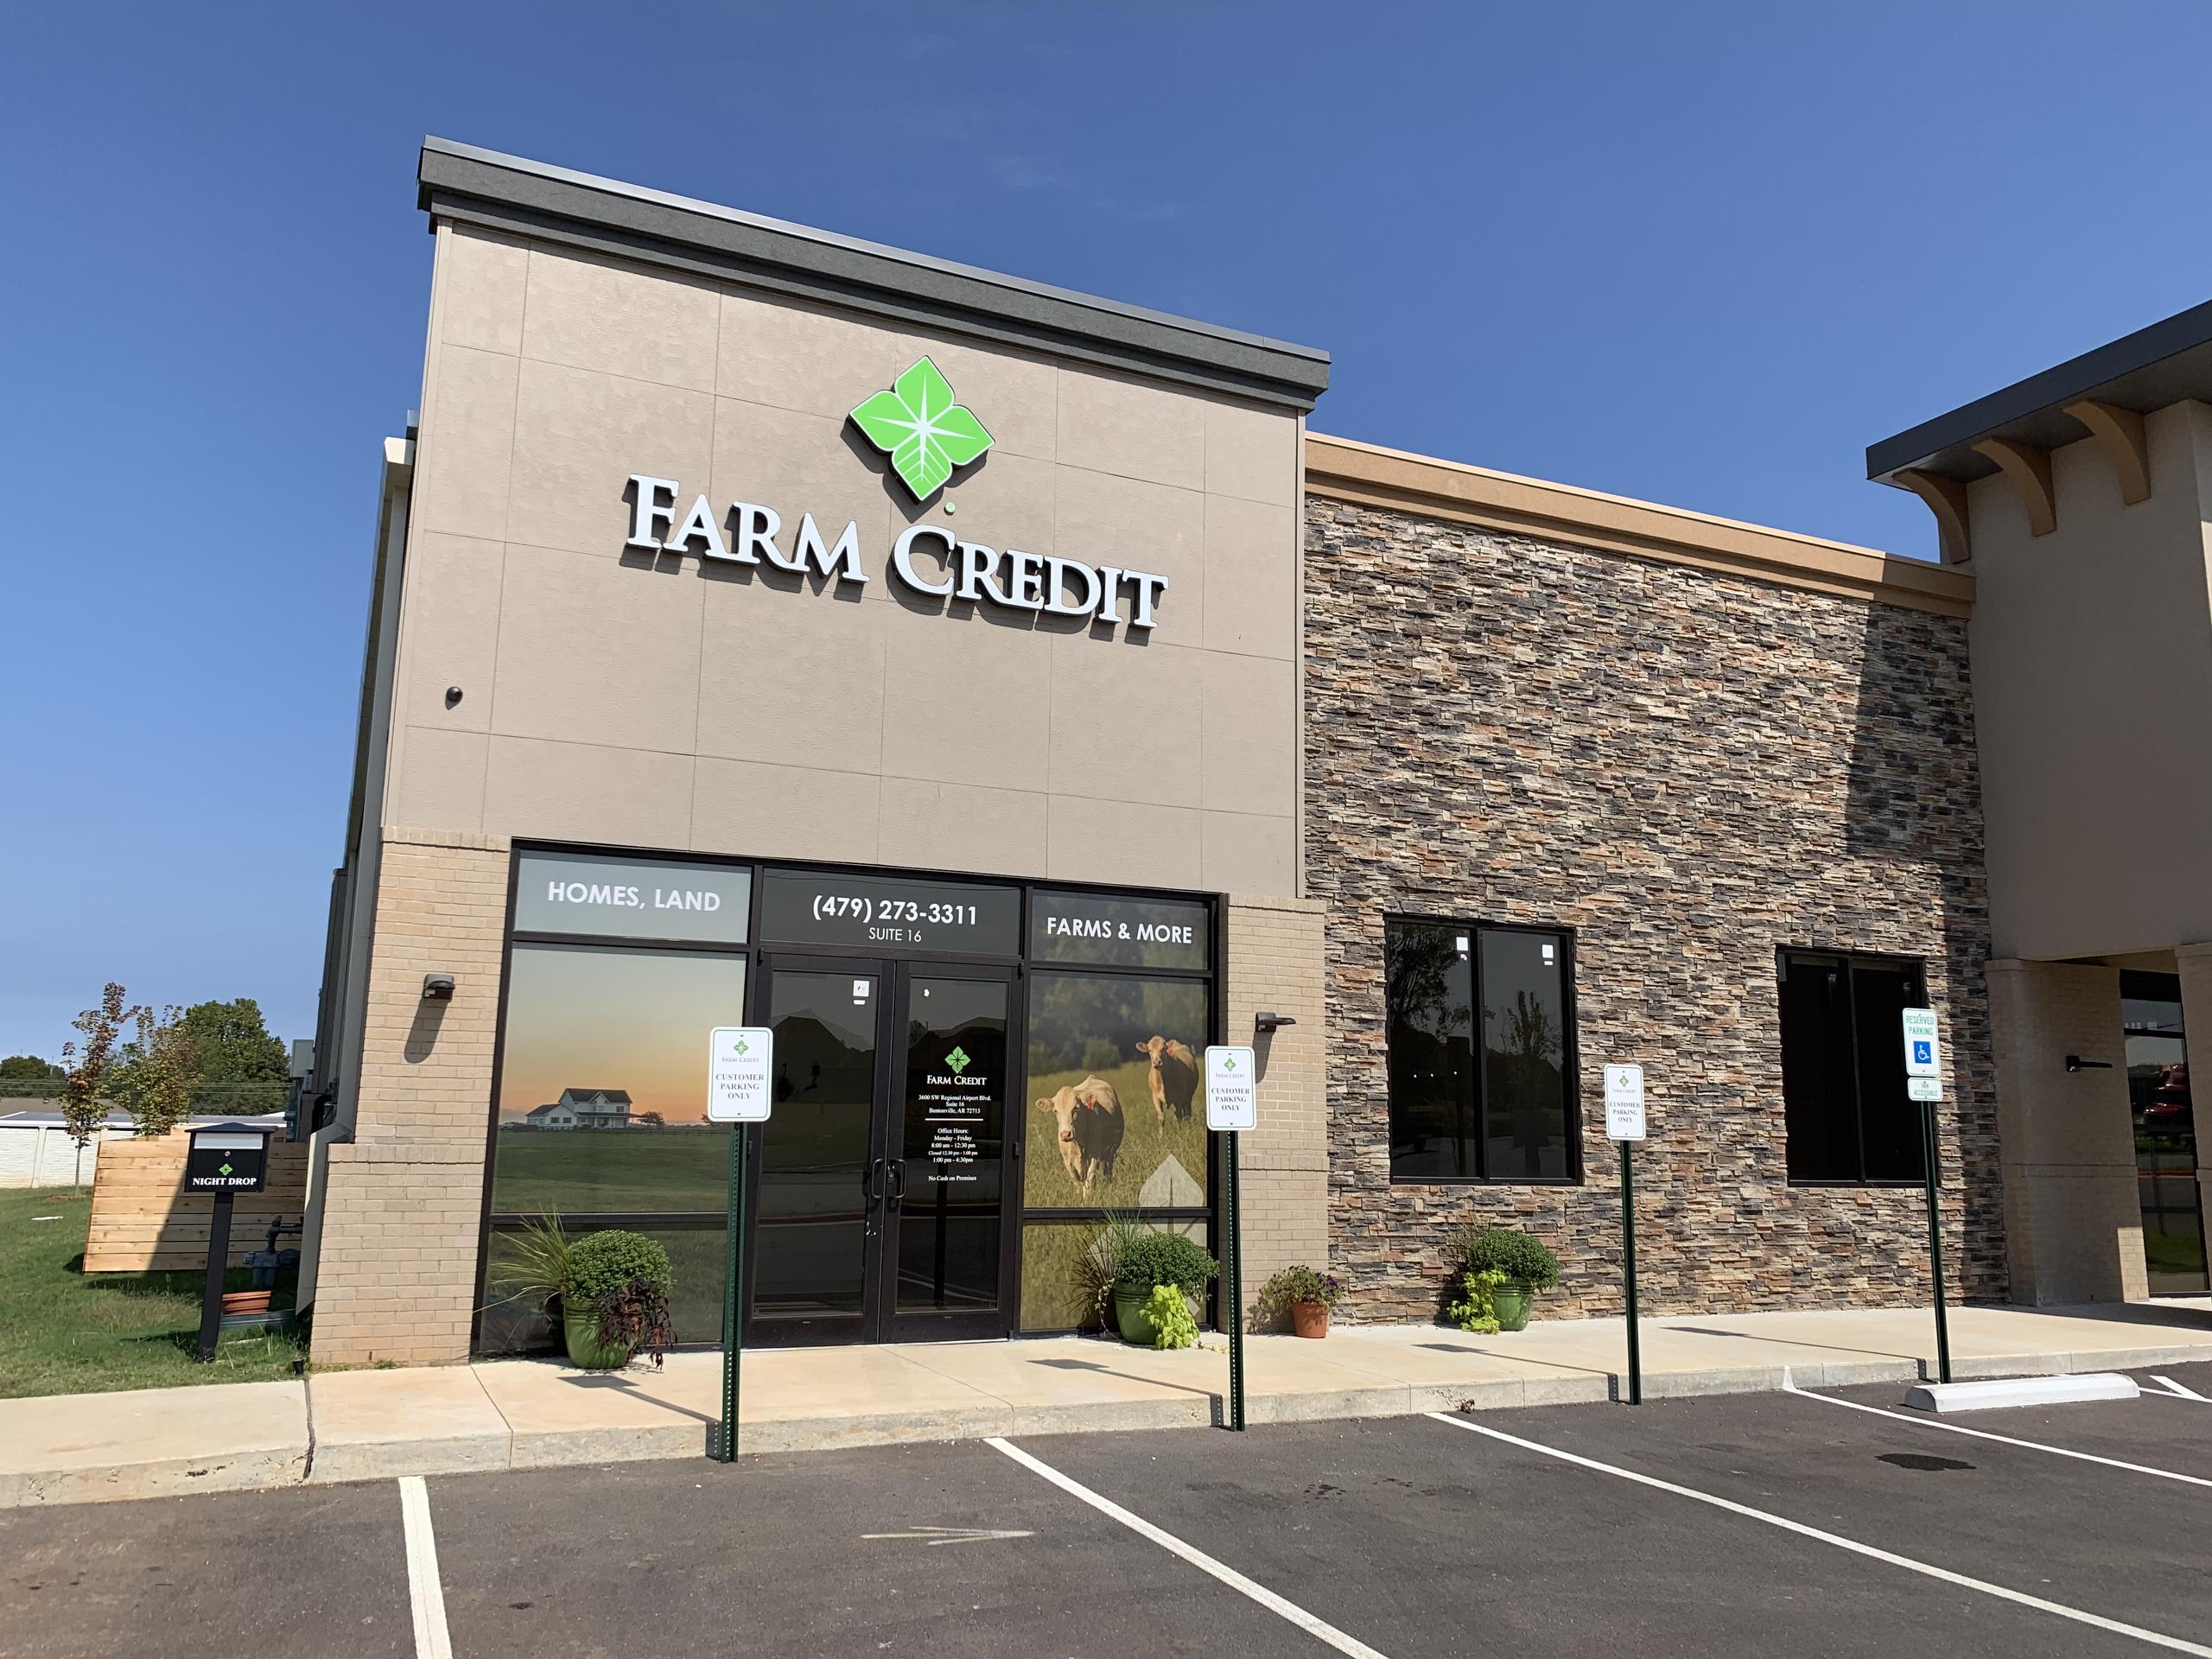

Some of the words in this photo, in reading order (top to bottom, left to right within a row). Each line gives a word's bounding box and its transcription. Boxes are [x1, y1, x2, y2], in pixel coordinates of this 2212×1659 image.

[626, 473, 871, 584] FARM
[893, 524, 1169, 630] CREDIT
[547, 880, 646, 910] HOMES,
[654, 888, 721, 912] LAND
[812, 893, 874, 924] (479)
[879, 898, 977, 925] 273-3311
[868, 927, 904, 942] SUITE
[906, 929, 922, 943] 16
[1046, 916, 1113, 939] FARMS
[1117, 922, 1131, 941] &
[1136, 922, 1193, 944] MORE
[1905, 1014, 1935, 1025] RESERVED
[1908, 1027, 1934, 1036] PARKING
[926, 1074, 951, 1085] FARM
[954, 1075, 987, 1086] CREDIT
[192, 1177, 227, 1185] NIGHT
[227, 1177, 257, 1185] DROP
